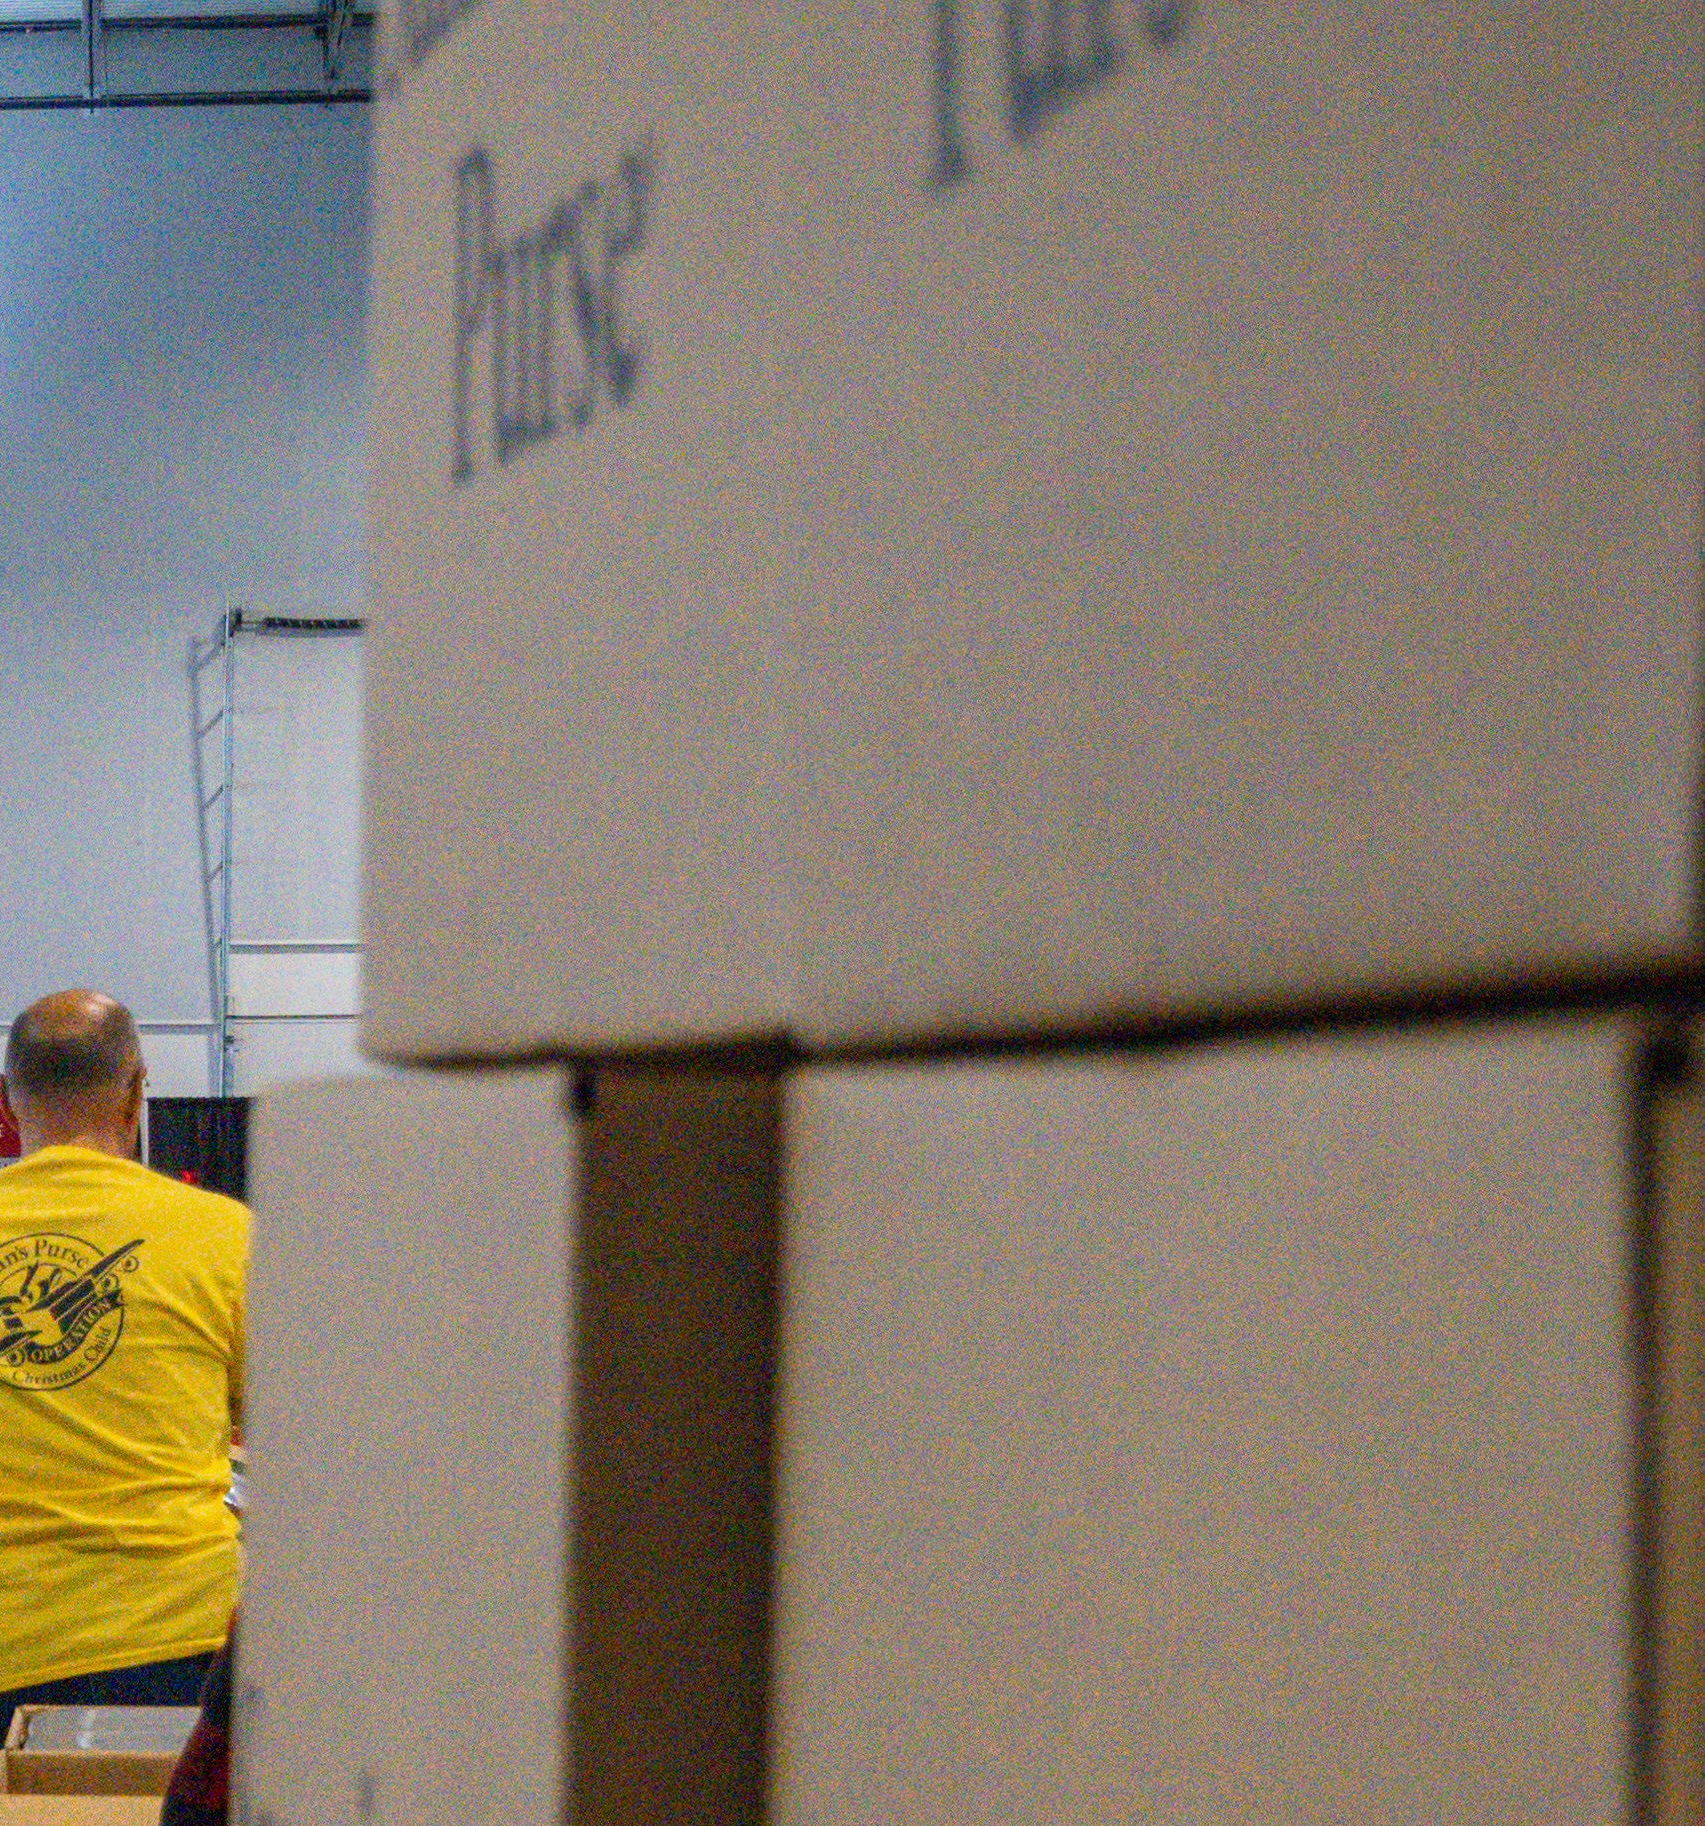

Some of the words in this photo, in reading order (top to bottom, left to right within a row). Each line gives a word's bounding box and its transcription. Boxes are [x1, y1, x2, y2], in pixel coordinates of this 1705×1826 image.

[34, 1238, 90, 1269] Purse
[12, 1360, 87, 1386] Christmas
[83, 1324, 112, 1363] Child
[31, 1297, 113, 1363] OPERATION
